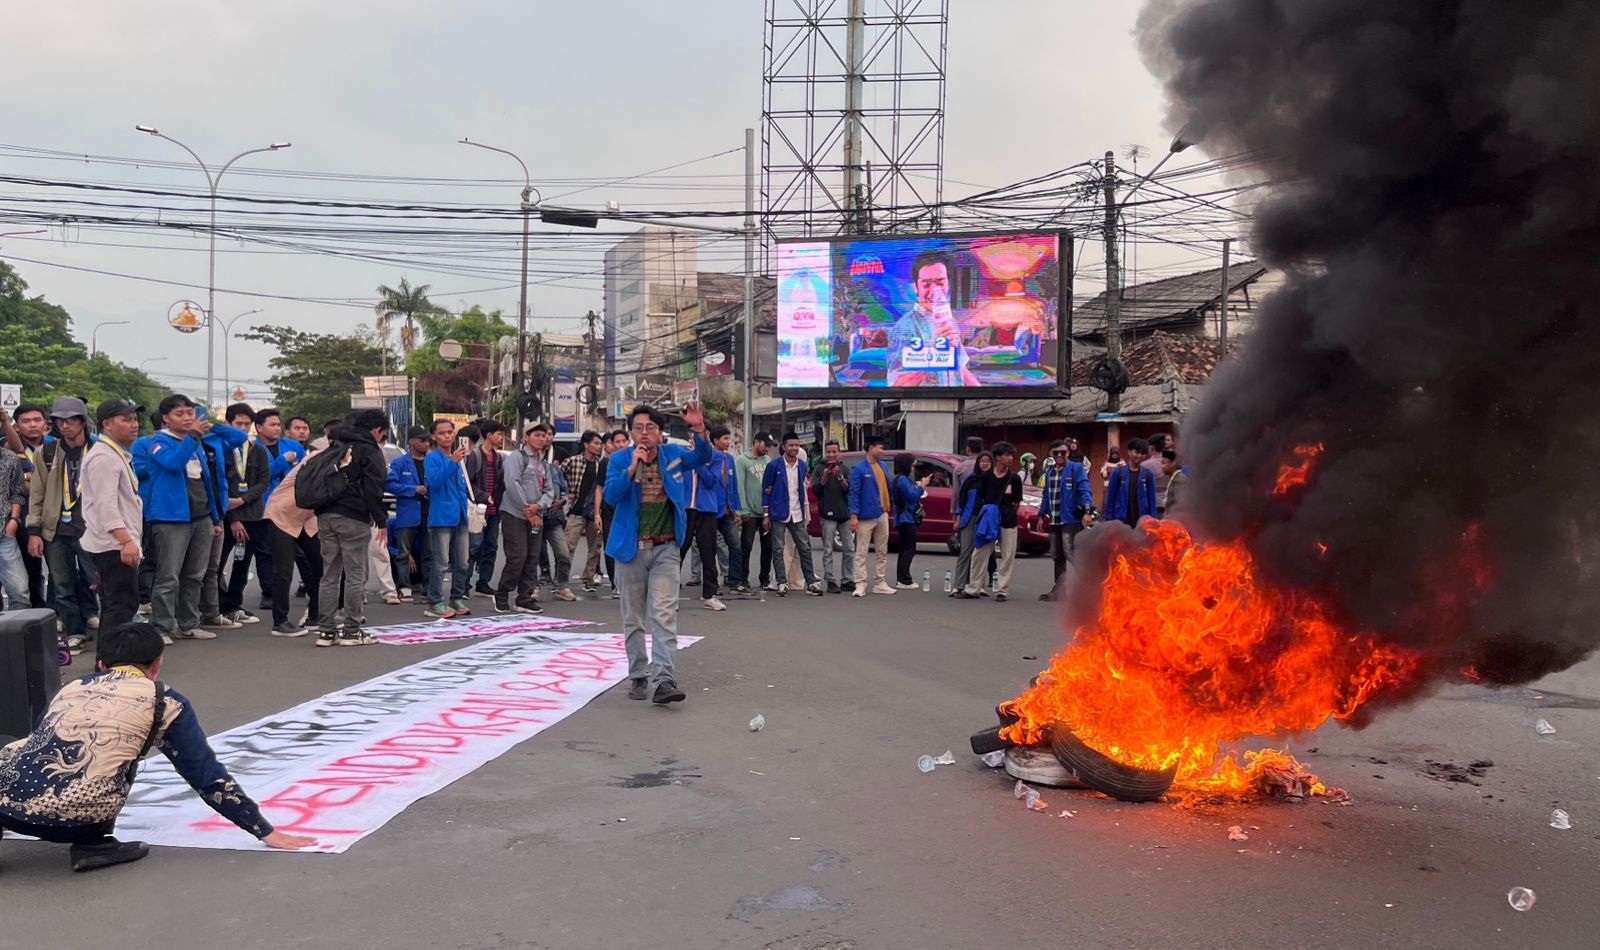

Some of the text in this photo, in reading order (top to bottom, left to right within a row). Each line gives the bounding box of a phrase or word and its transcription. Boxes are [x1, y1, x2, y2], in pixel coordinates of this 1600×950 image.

[910, 337, 922, 349] 3
[935, 337, 947, 349] 2
[190, 691, 562, 834] PENDIDIKAN
[498, 679, 572, 695] &
